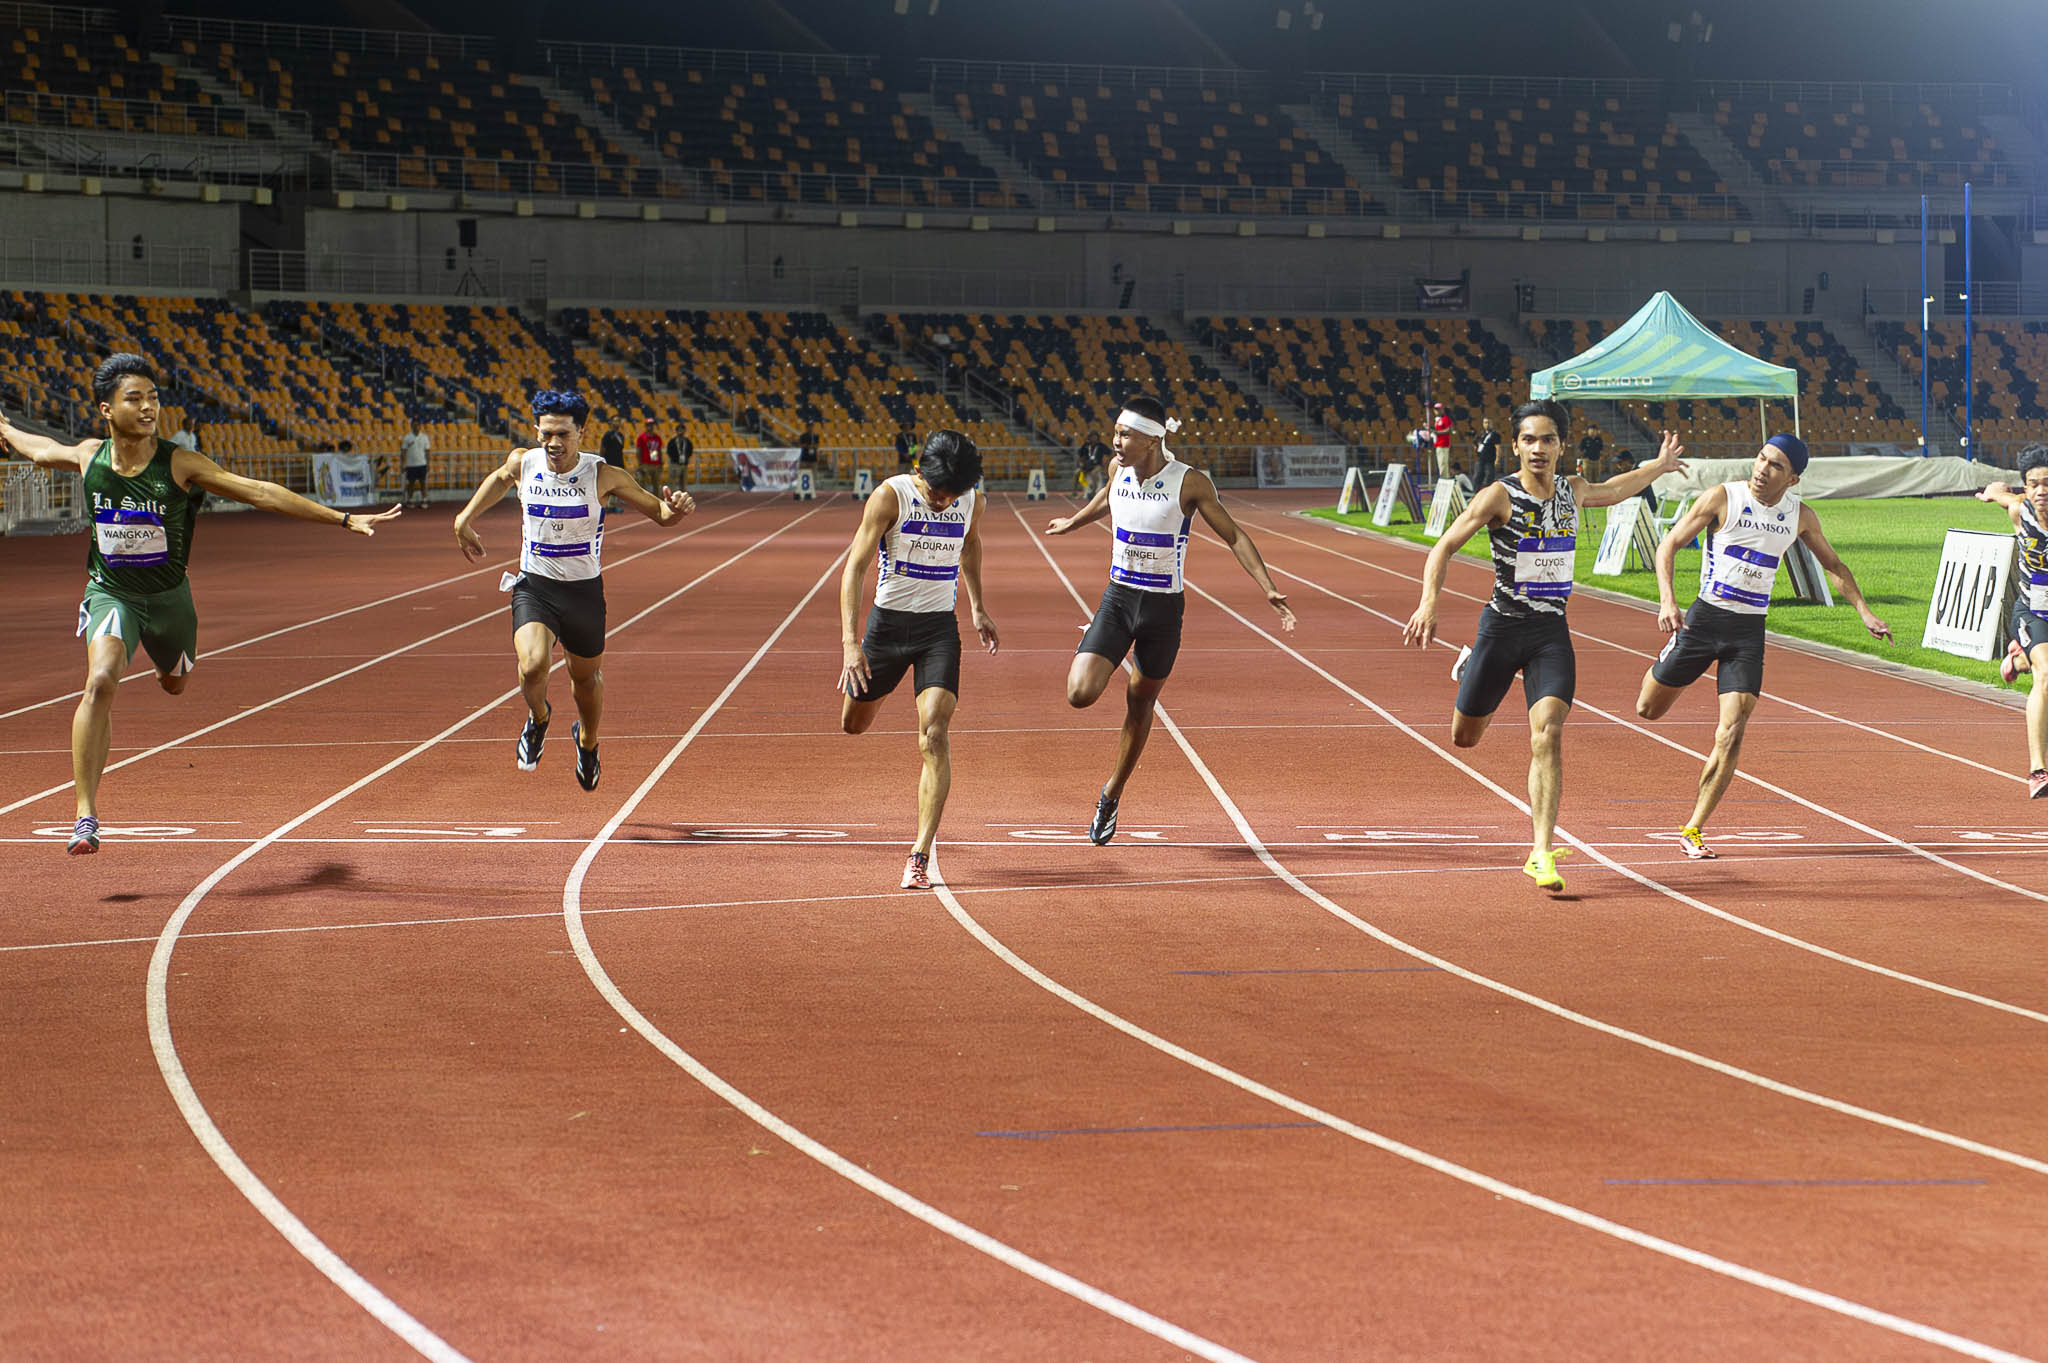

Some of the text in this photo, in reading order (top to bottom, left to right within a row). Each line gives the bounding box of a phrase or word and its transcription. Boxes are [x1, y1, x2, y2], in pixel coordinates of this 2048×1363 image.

[801, 474, 811, 491] 8
[858, 473, 868, 490] 7
[1032, 473, 1042, 490] 4
[527, 485, 587, 498] ADAMSON
[1117, 488, 1170, 503] ADAMSON
[92, 492, 167, 515] La Salle
[907, 512, 966, 522] ADAMSON
[551, 522, 565, 532] YU
[1736, 519, 1792, 535] ADAMSON
[103, 530, 156, 539] WANGKAY
[910, 540, 956, 552] TADURAN
[1124, 548, 1159, 560] RINGEL
[1534, 558, 1565, 567] CUYOS
[1737, 566, 1763, 579] FRIAS
[1936, 560, 1997, 633] UAAP
[31, 826, 198, 837] 8
[364, 826, 529, 837] 7
[690, 828, 849, 838] 6
[1007, 829, 1170, 840] 5
[1322, 830, 1481, 840] 4
[1643, 831, 1806, 841] 3
